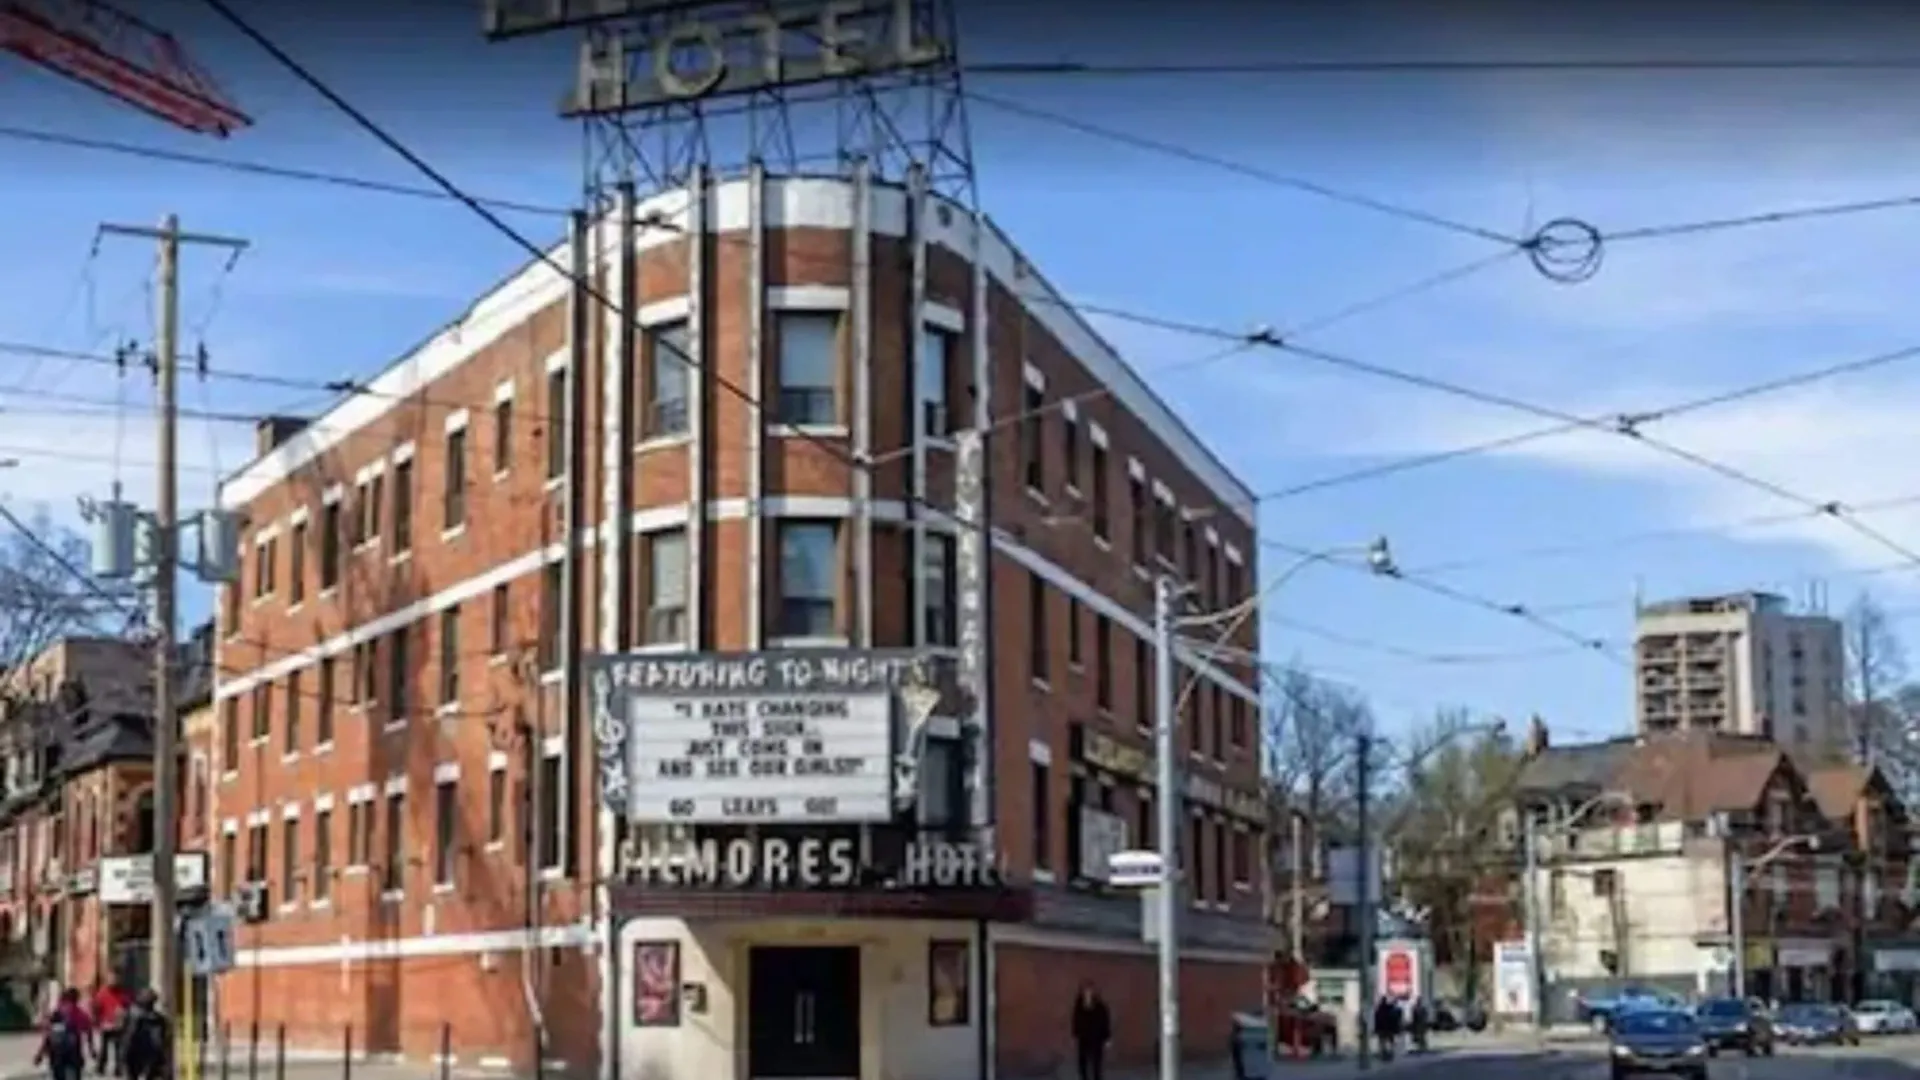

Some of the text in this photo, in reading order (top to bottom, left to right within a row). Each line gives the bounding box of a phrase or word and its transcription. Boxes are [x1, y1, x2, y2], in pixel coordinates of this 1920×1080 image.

[577, 0, 945, 108] HOTEL
[612, 658, 766, 687] FEATURING
[756, 701, 850, 720] CHANGING
[710, 719, 750, 737] THIS
[685, 739, 824, 757] JUST COME IN
[657, 757, 693, 777] AND
[706, 757, 740, 777] SEE
[749, 757, 787, 777] OUR
[668, 797, 696, 816] GO
[617, 837, 1014, 888] FILMORES HOTEL
